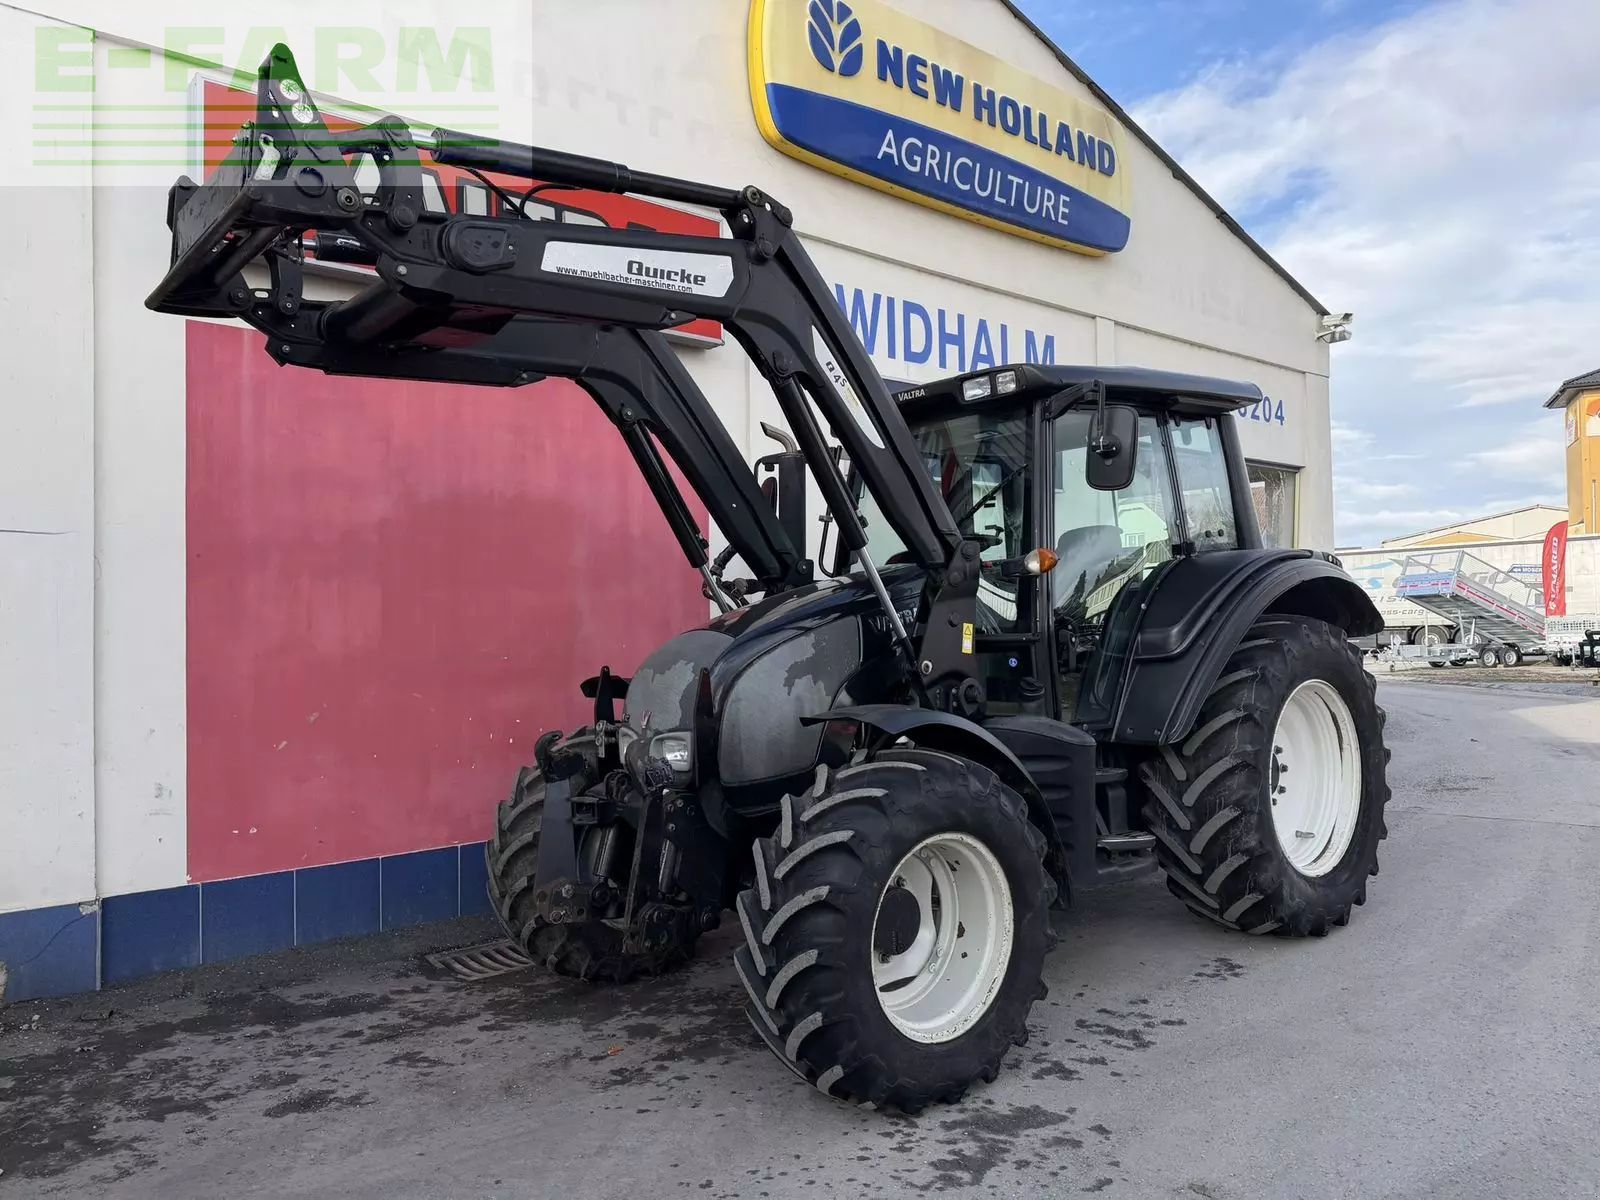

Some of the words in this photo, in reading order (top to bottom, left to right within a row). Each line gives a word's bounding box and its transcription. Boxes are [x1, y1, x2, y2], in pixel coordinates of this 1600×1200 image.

[876, 38, 964, 112] NEW
[972, 81, 1116, 177] HOLLAND
[877, 129, 1070, 225] AGRICULTURE
[556, 265, 693, 293] www.muehlbacher-maschinen.com
[627, 259, 707, 287] Quicke
[898, 388, 926, 402] VALTRA
